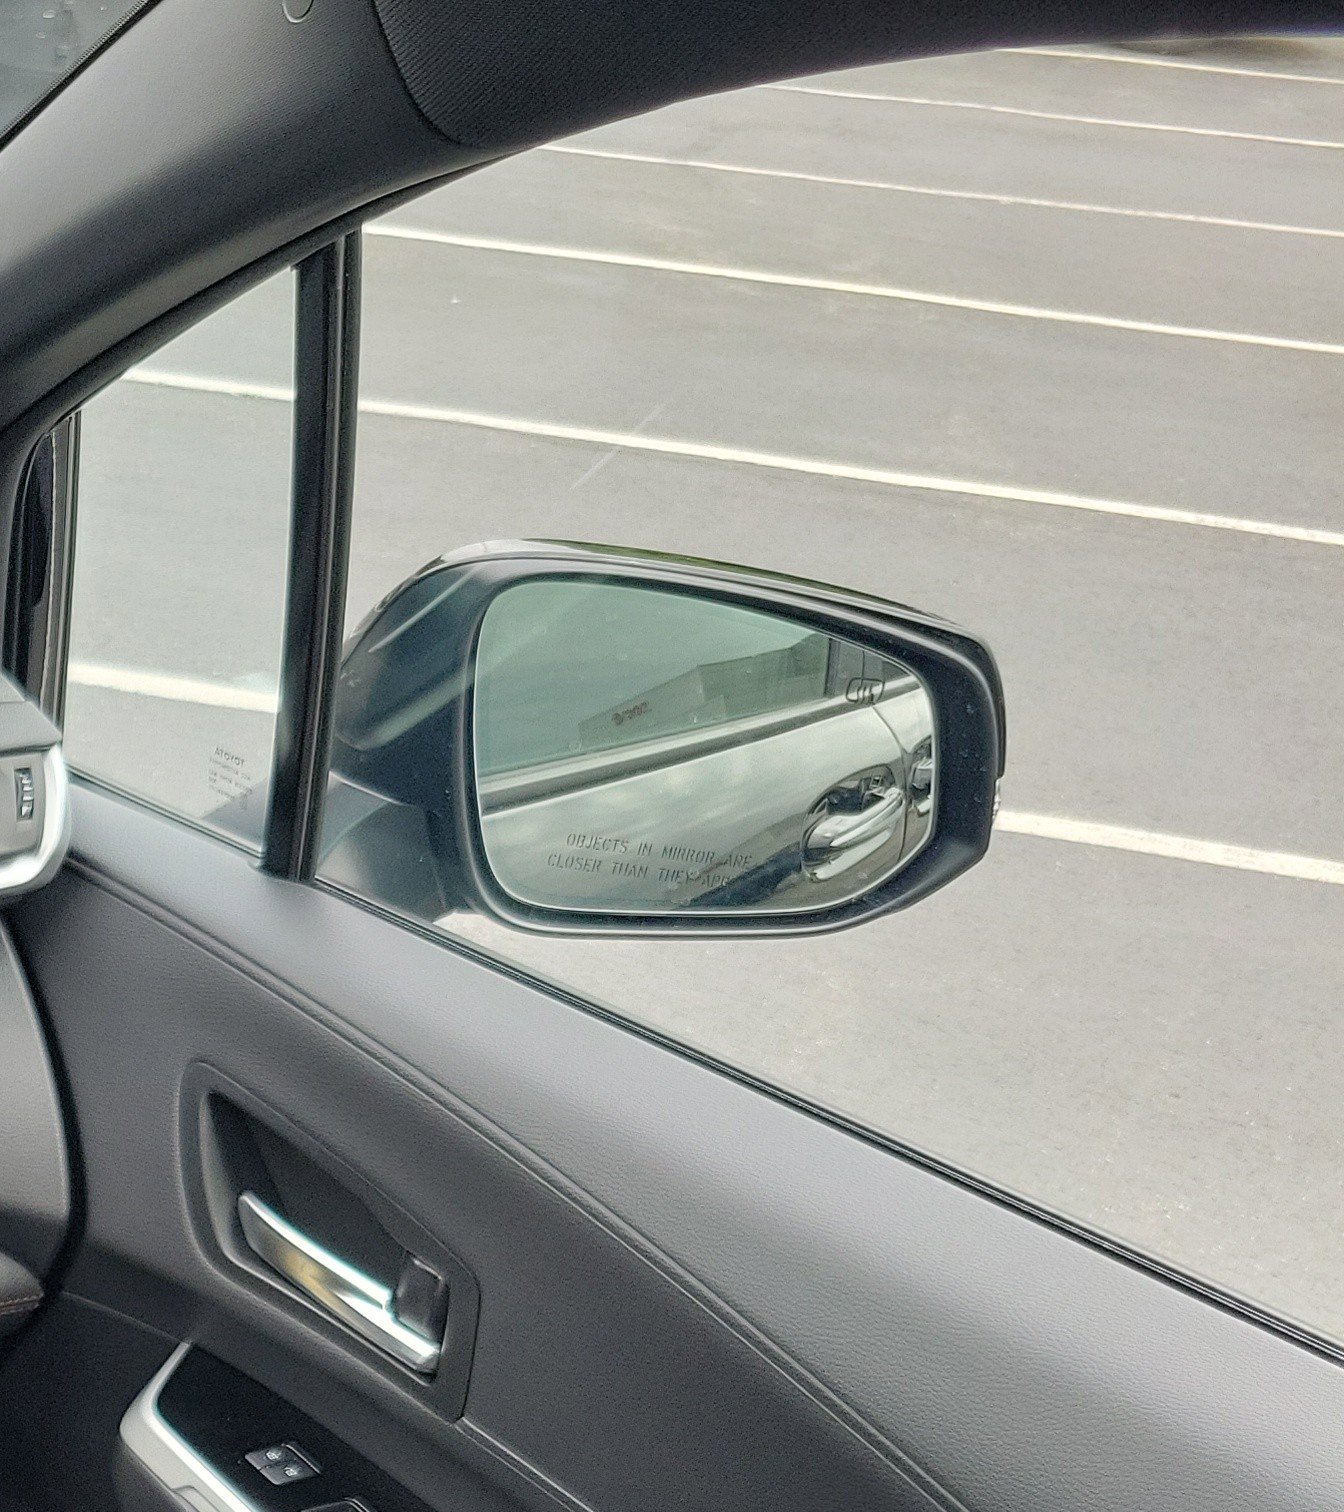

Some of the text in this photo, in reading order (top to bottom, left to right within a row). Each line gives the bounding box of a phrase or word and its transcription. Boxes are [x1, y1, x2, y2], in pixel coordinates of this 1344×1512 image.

[566, 833, 752, 868] OBJECTS IN MIRROR ARE
[547, 853, 602, 872] CLOSER
[612, 862, 648, 878] THAN
[659, 868, 695, 884] THEY
